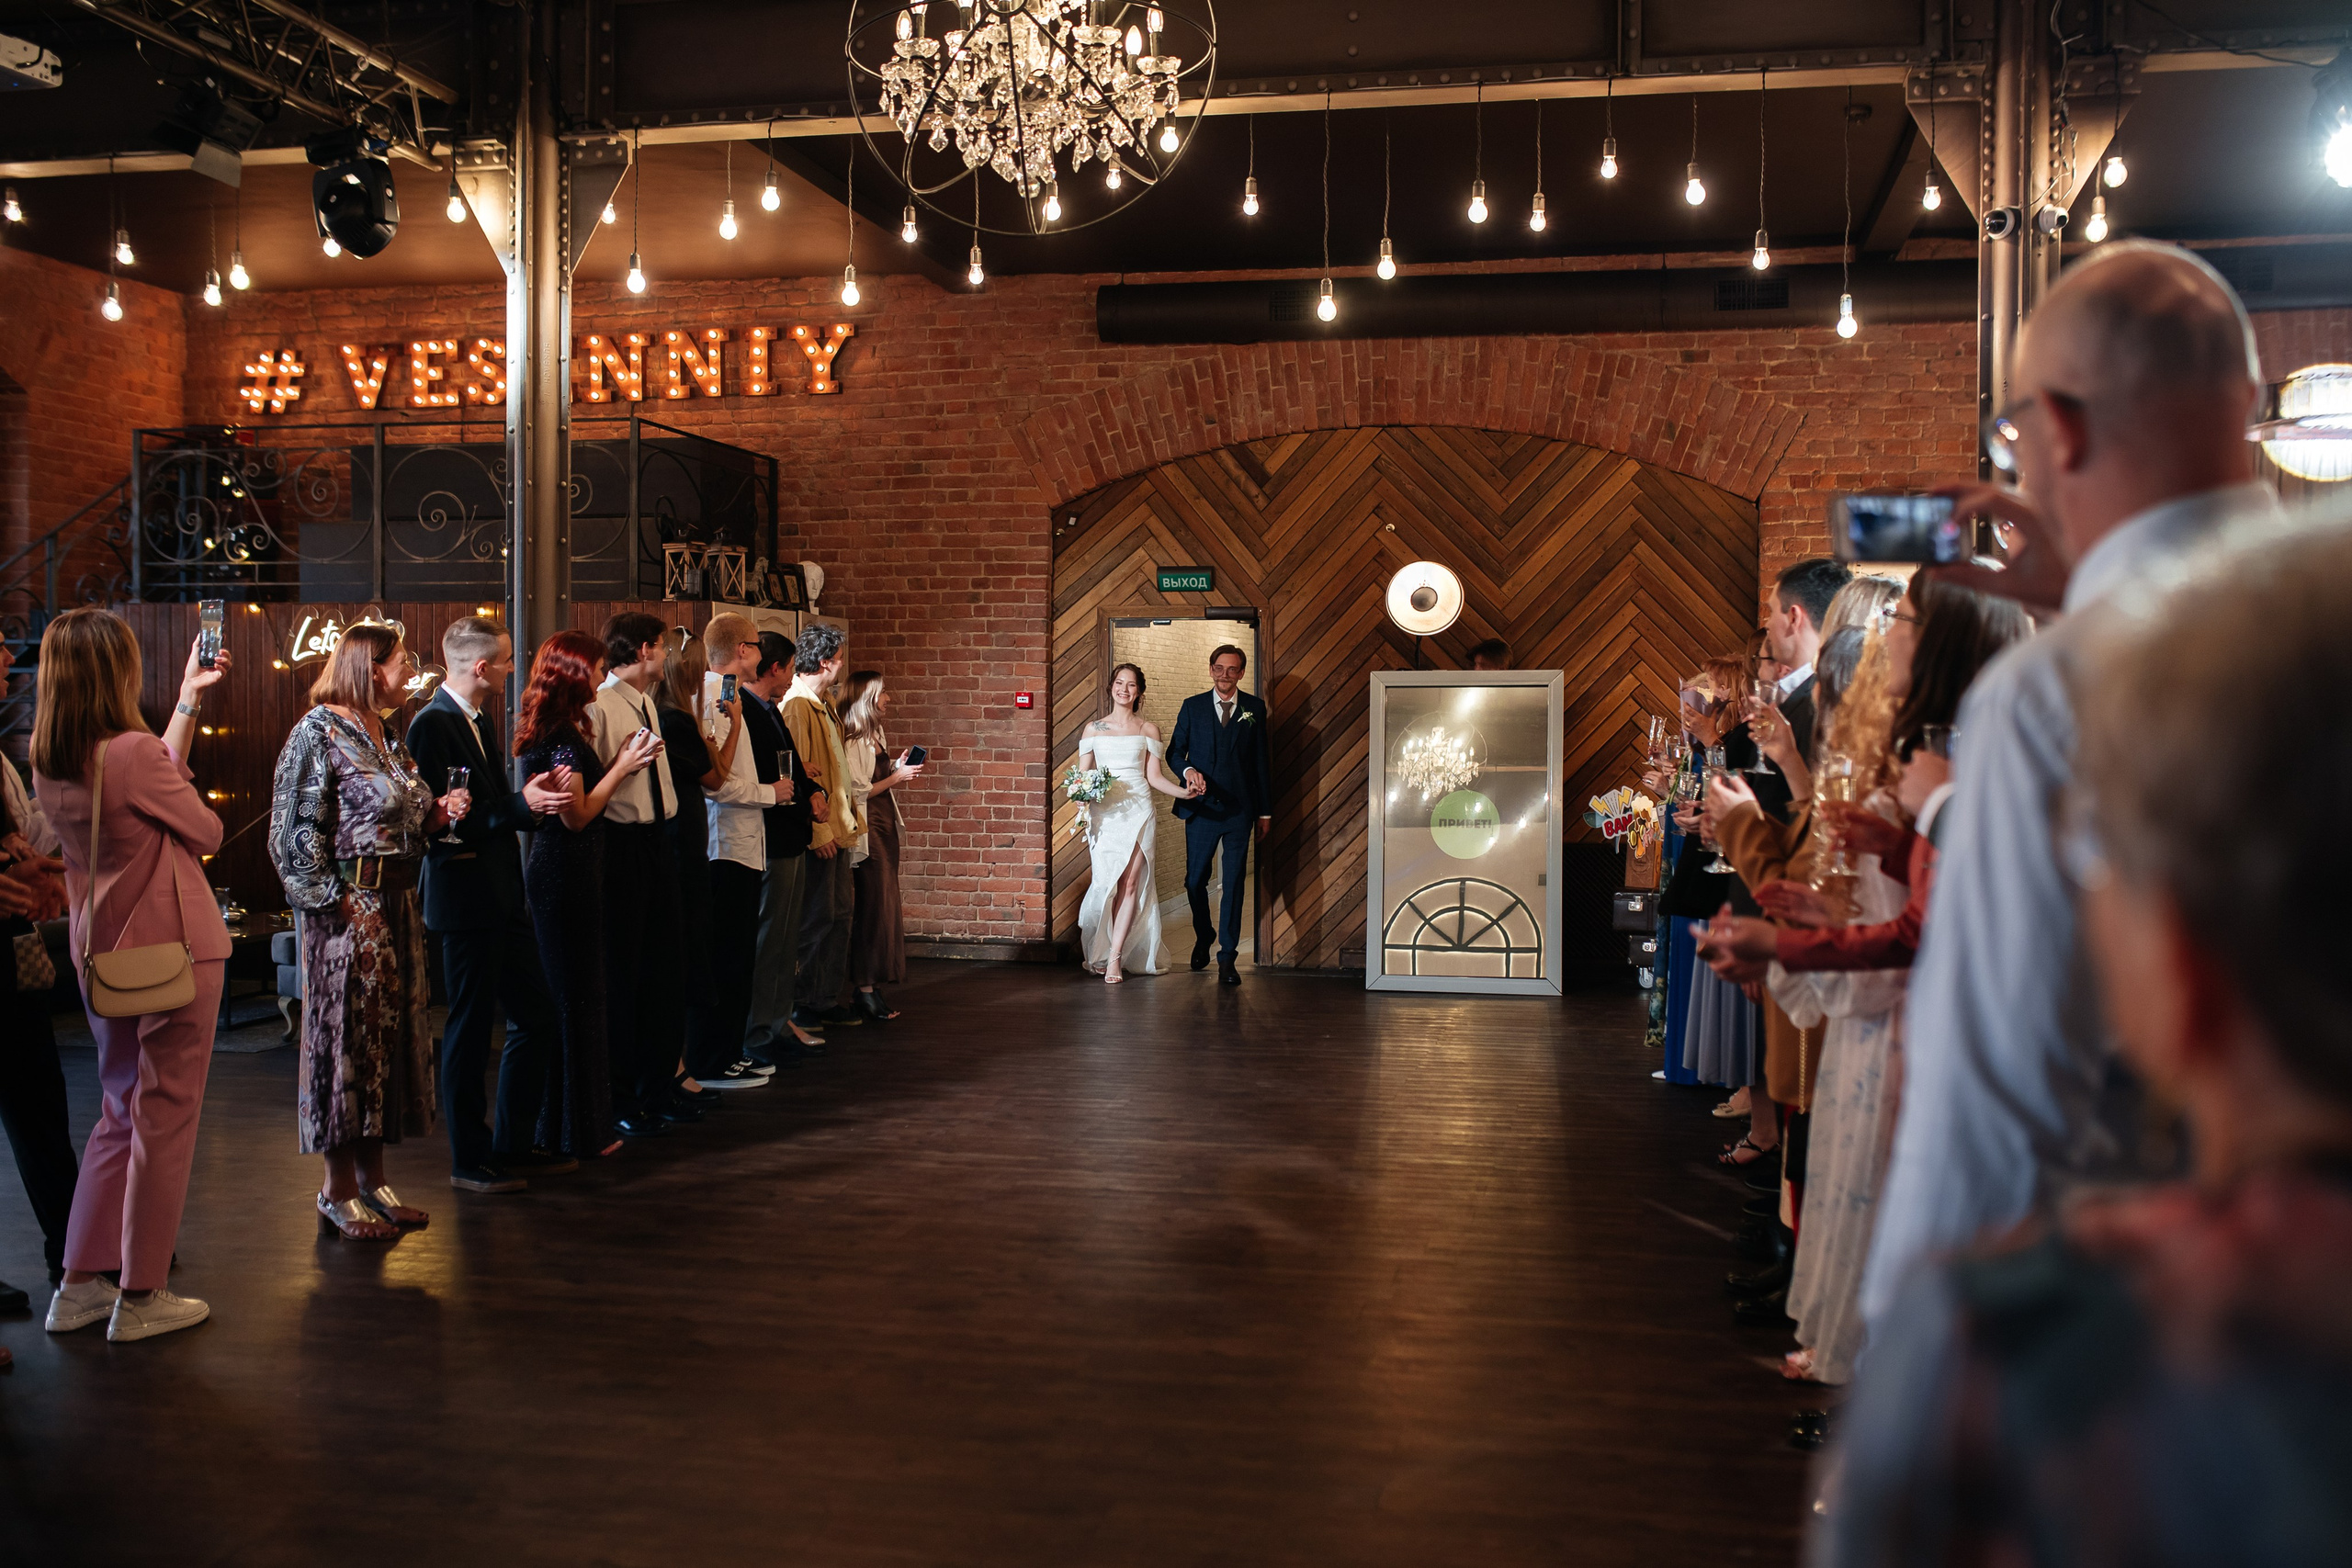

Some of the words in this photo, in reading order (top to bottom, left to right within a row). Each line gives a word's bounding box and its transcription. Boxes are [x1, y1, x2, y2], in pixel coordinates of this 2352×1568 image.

[339, 323, 854, 410] VESNNIY
[1162, 577, 1208, 589] ВЫХОД
[1439, 818, 1492, 829] ПРИВЕТ!
